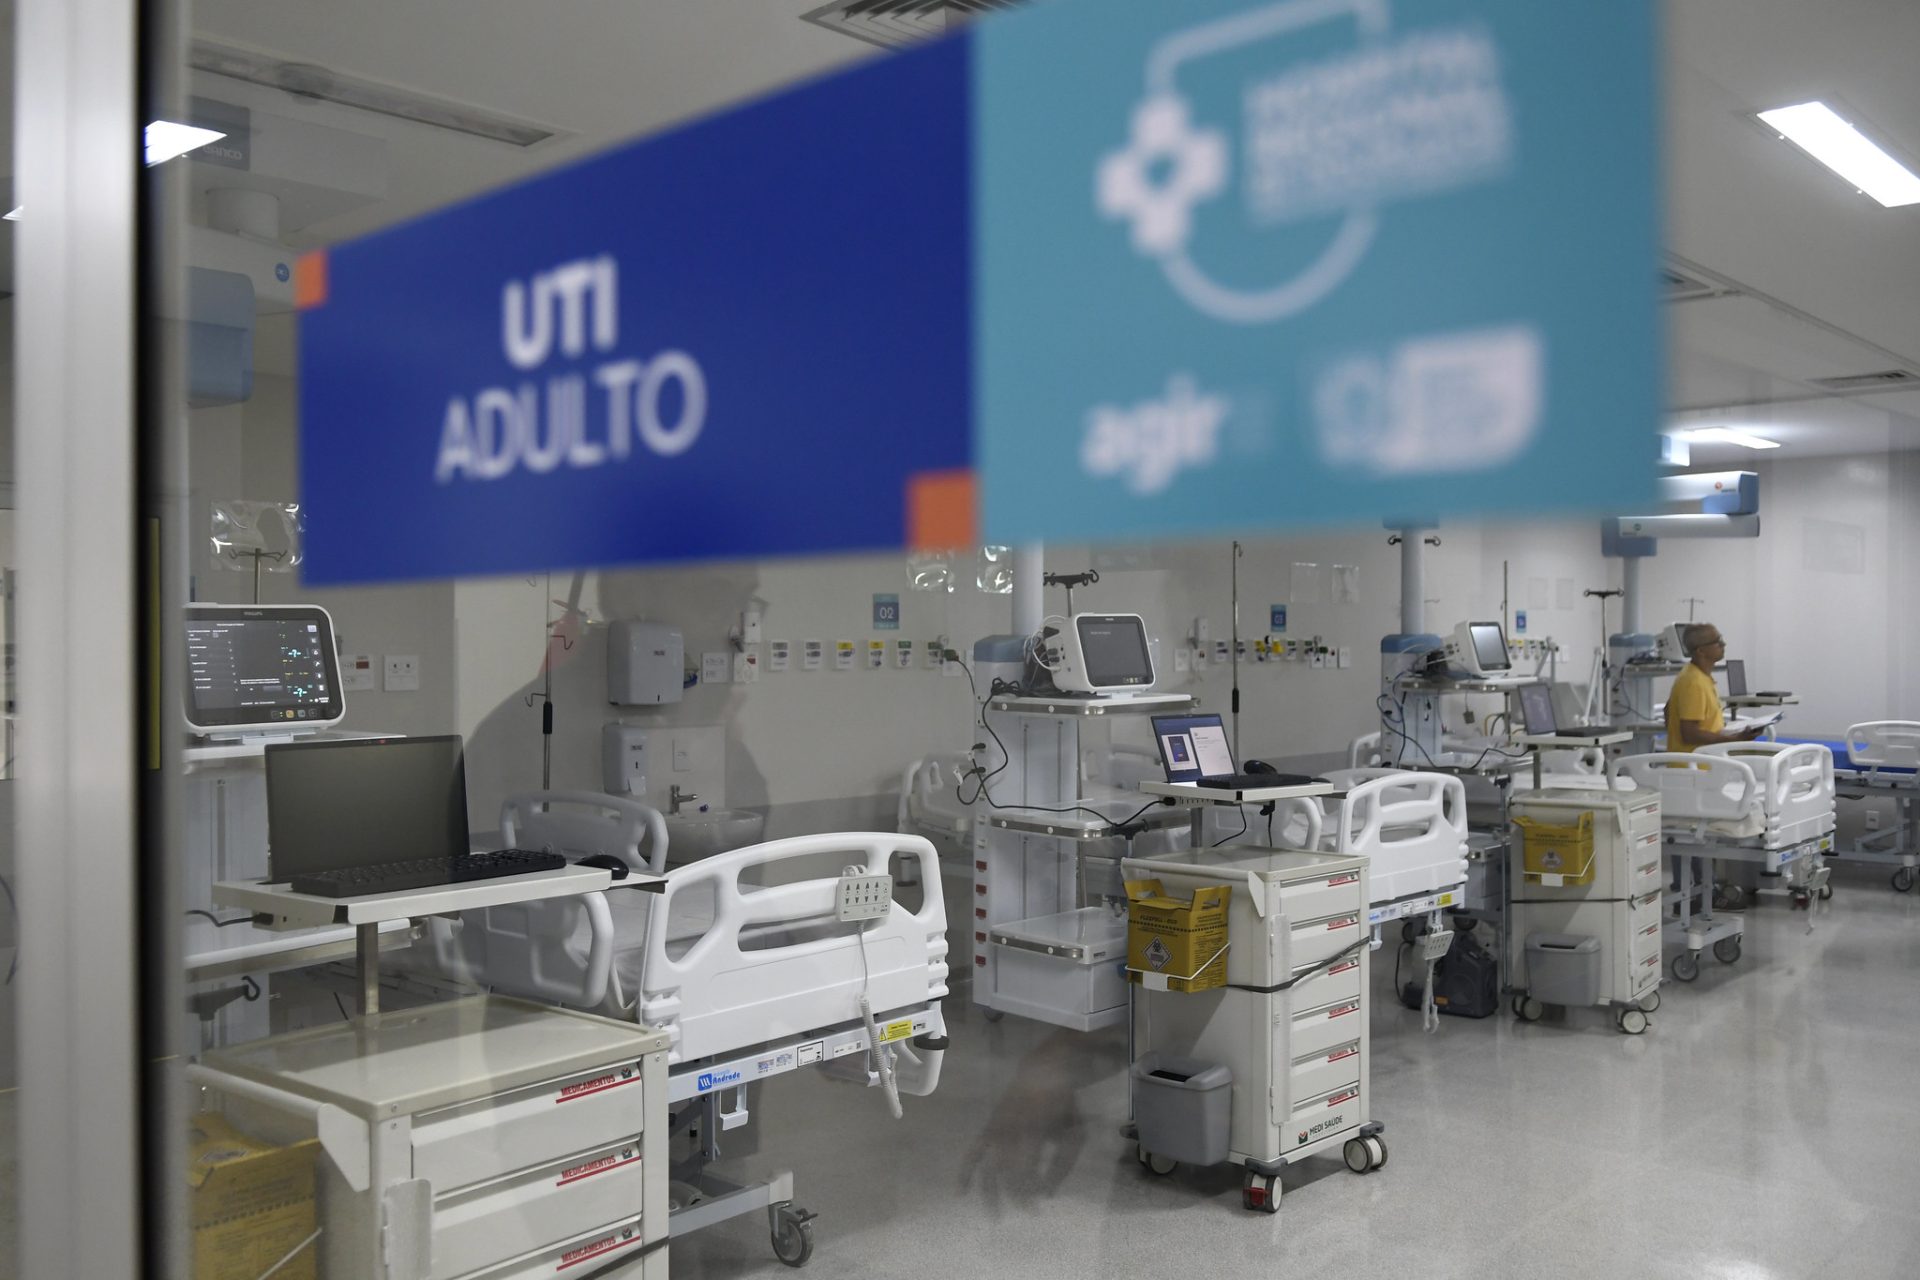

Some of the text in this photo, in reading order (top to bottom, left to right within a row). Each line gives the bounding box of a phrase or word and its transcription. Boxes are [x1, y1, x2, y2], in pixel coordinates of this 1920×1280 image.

[503, 254, 618, 369] UTI
[434, 350, 708, 483] ADULTO
[879, 606, 894, 619] 02
[561, 1073, 616, 1096] MEDICAMENTOS
[712, 1071, 741, 1084] Andrade
[1309, 1122, 1324, 1136] MEDI
[561, 1154, 617, 1180] MEDICAMENTOS
[561, 1235, 617, 1263] MEDICAMENTOS
